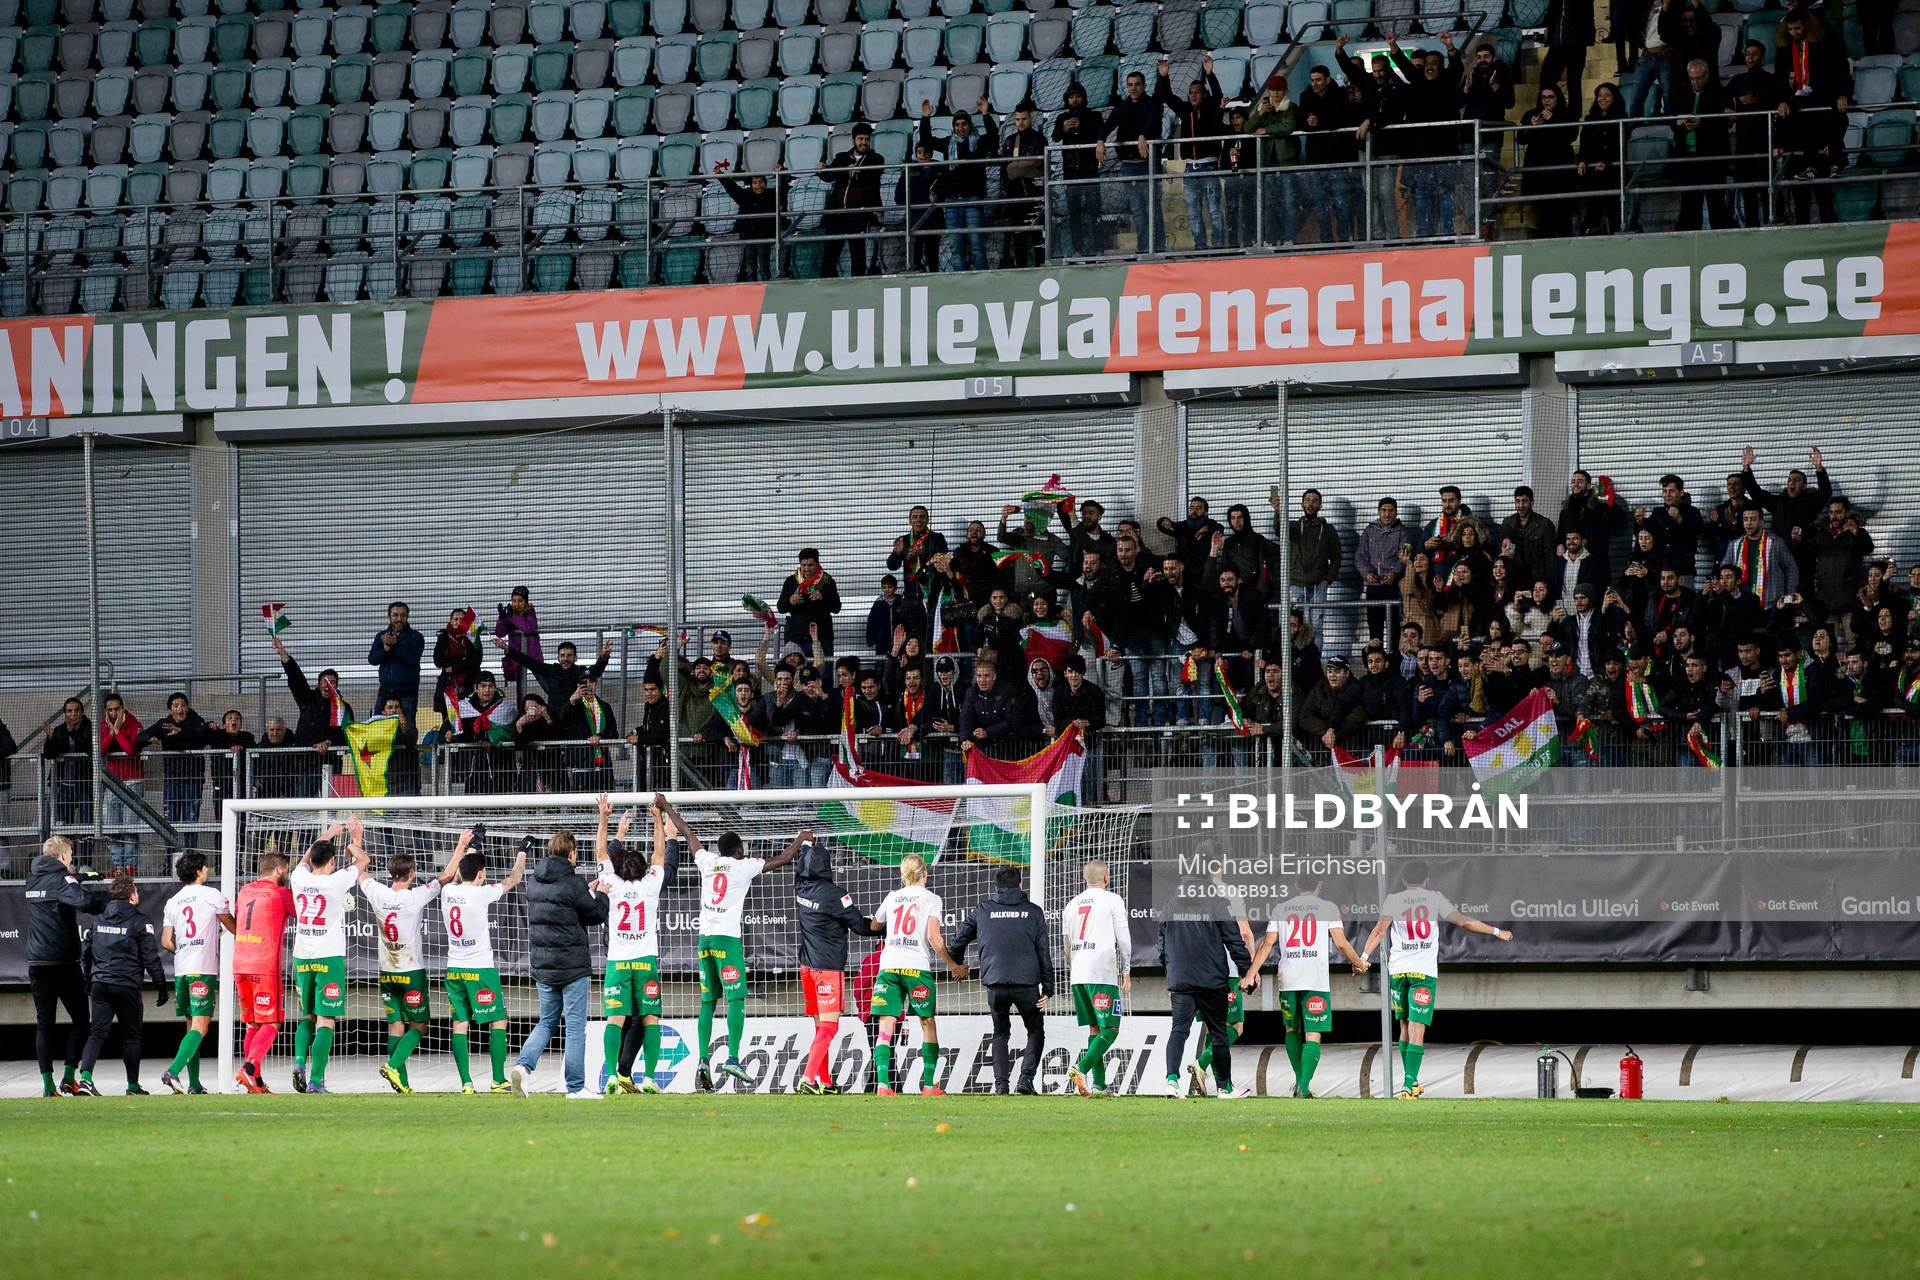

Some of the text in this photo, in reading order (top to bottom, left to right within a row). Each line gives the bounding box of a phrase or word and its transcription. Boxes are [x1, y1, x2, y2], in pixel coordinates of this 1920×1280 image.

[575, 254, 1884, 381] www.ulleviarenachallenge.se
[1494, 717, 1524, 738] DAL
[711, 873, 728, 906] 9
[245, 898, 257, 931] 1
[296, 893, 327, 926] 22
[616, 900, 646, 931] 21
[744, 915, 788, 925] Got Event
[893, 903, 917, 936] 16
[990, 911, 1020, 919] DALKURD
[1130, 908, 1148, 919] Got
[1350, 903, 1369, 914] Got
[1461, 903, 1489, 913] Event
[1510, 899, 1639, 918] Gamla Ullevi
[1671, 901, 1720, 911] Got Event
[1768, 900, 1818, 911] Got Event
[1841, 896, 1911, 915] Gamla
[0, 928, 19, 938] vent
[182, 905, 197, 939] 3
[384, 912, 399, 943] 6
[449, 905, 464, 938] 8
[1078, 905, 1092, 940] 7
[1285, 912, 1318, 948] 20
[1401, 904, 1431, 940] 18
